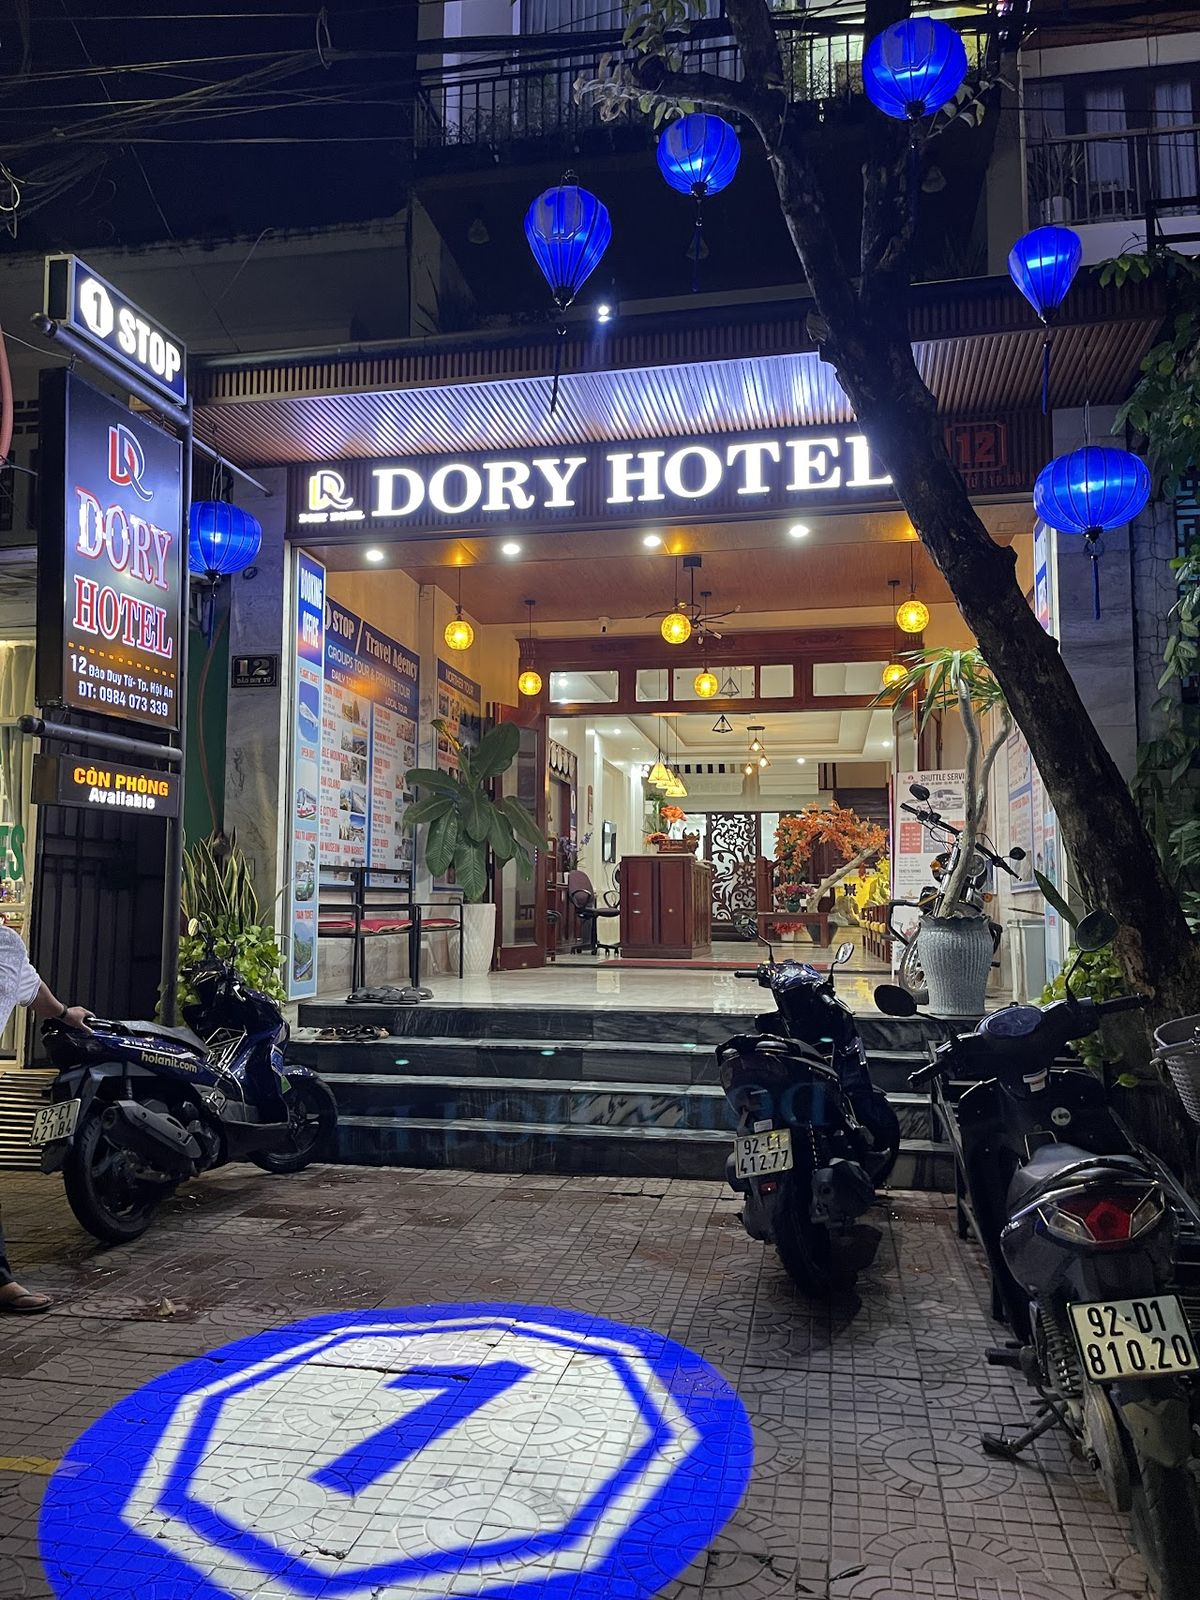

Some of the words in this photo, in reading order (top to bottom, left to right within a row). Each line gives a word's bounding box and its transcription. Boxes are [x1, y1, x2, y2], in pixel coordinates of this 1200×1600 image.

[118, 307, 181, 382] STOP
[956, 431, 995, 464] 12
[371, 457, 587, 517] DORY
[606, 434, 894, 503] HOTEL
[76, 486, 172, 591] DORY
[73, 574, 173, 659] HOTEL
[332, 611, 355, 640] STOP
[365, 631, 391, 664] Travel
[393, 648, 418, 681] Agency
[71, 654, 87, 675] 12
[89, 664, 105, 680] Đào
[107, 669, 122, 686] Duy
[137, 678, 149, 692] Tp.
[164, 686, 174, 699] An
[237, 658, 270, 676] 12
[328, 644, 353, 670] GROUPS
[354, 658, 371, 679] TOUR
[398, 682, 411, 700] TOUR
[78, 680, 97, 699] ĐT:
[99, 686, 126, 707] 0984
[129, 694, 147, 712] 073
[150, 699, 168, 717] 339
[74, 766, 110, 788] CÒN
[115, 774, 168, 797] PHÒNG
[920, 773, 946, 782] SHUTTLE
[947, 772, 965, 781] SERVI
[88, 787, 155, 810] Available
[141, 1051, 198, 1073] hoianit.com
[33, 1119, 71, 1143] 421.84
[40, 1104, 71, 1125] 92-C1
[740, 1149, 788, 1174] 412.77
[744, 1134, 781, 1155] 92-C1
[1087, 1300, 1167, 1338] 92-D1
[1086, 1334, 1191, 1375] 810.20
